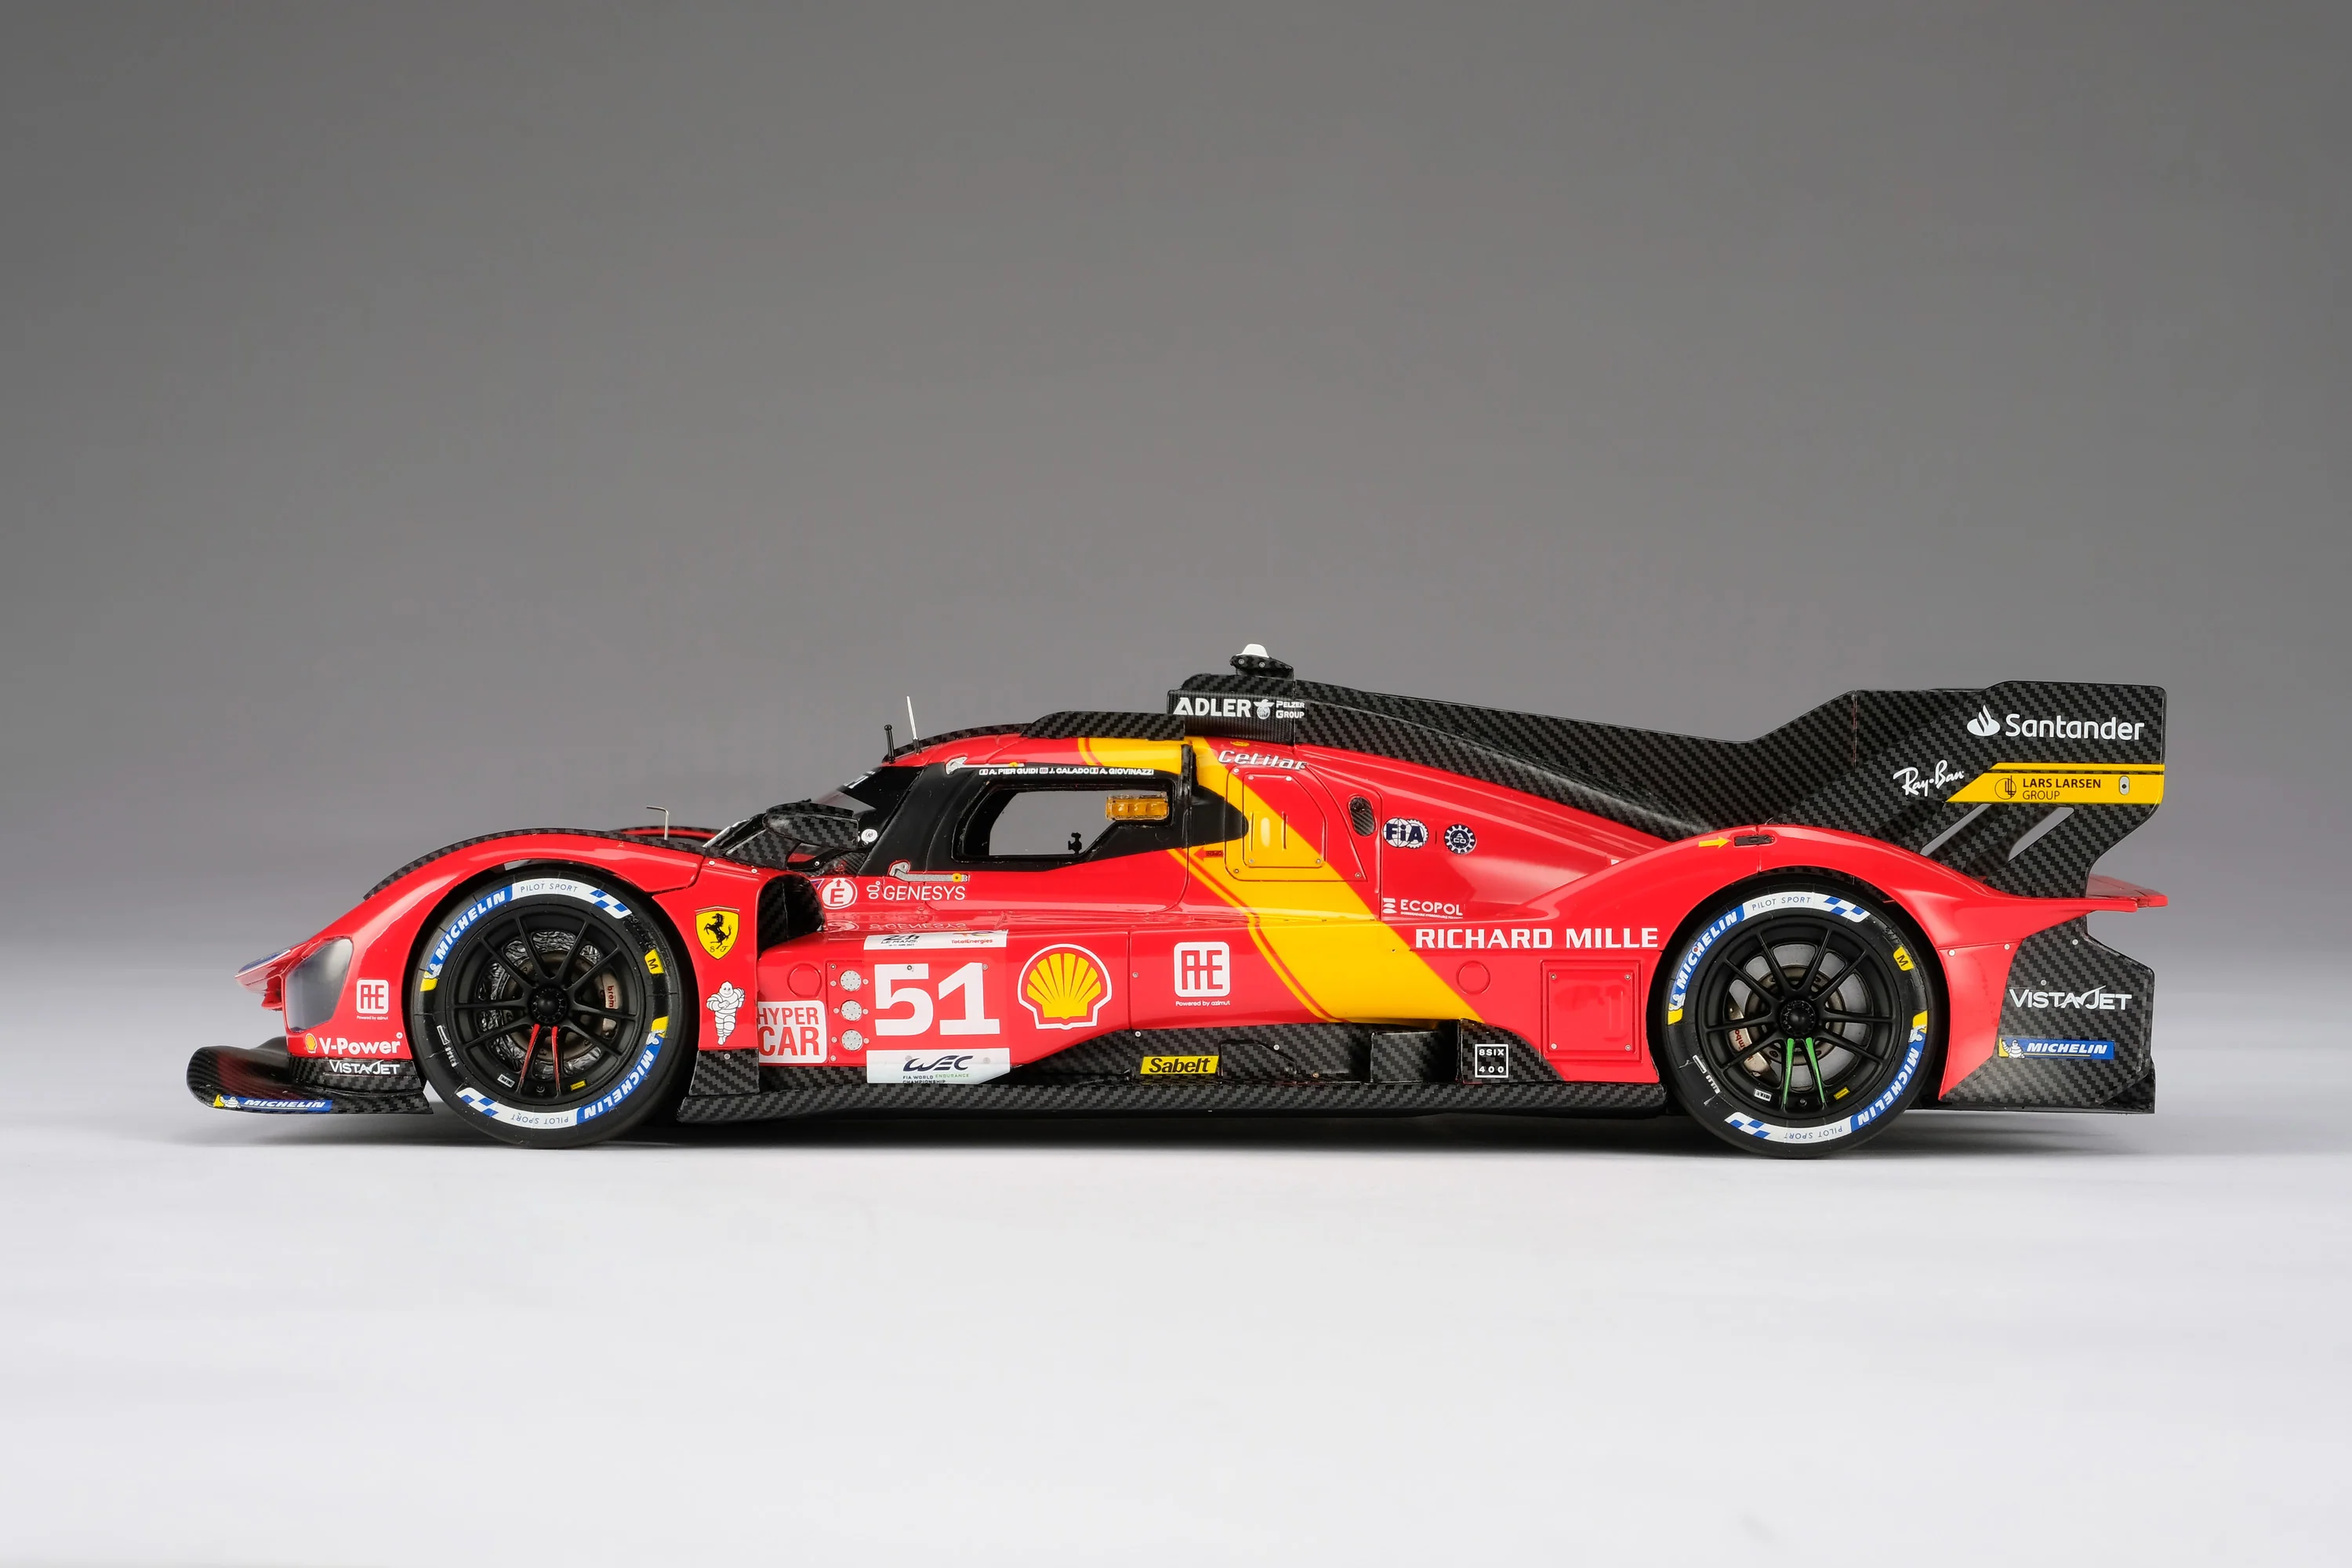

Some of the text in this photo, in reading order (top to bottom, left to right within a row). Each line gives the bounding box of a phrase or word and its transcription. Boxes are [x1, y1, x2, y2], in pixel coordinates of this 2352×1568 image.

[1174, 697, 1250, 717] ADLER
[1276, 710, 1305, 719] GROUP
[2005, 713, 2144, 741] Santander
[1218, 750, 1307, 770] Cetilar
[2023, 779, 2101, 789] LARS LARSEN
[2023, 790, 2060, 800] GROUP
[521, 884, 578, 892] PILOT SPORT
[883, 886, 966, 900] GENESYS
[1400, 899, 1463, 916] ECOPOL
[1752, 898, 1776, 910] PILOT
[435, 891, 506, 961] MICHELIN
[1415, 927, 1658, 949] RICHARD MILLE
[1676, 911, 1737, 990] MICHELIN
[648, 958, 659, 970] M
[1897, 955, 1909, 967] M
[874, 962, 1000, 1036] 51
[757, 1007, 819, 1026] HYPER
[319, 1037, 401, 1054] V-Power
[758, 1026, 820, 1056] CAR
[2027, 1043, 2107, 1054] MICHELIN
[903, 1055, 973, 1072] WEC
[1149, 1057, 1210, 1073] Sabelt
[584, 1049, 654, 1120] MICHELIN
[1857, 1047, 1920, 1126] MICHELIN
[511, 1114, 569, 1125] PILOT SPORT
[1818, 1126, 1842, 1138] PILOT
